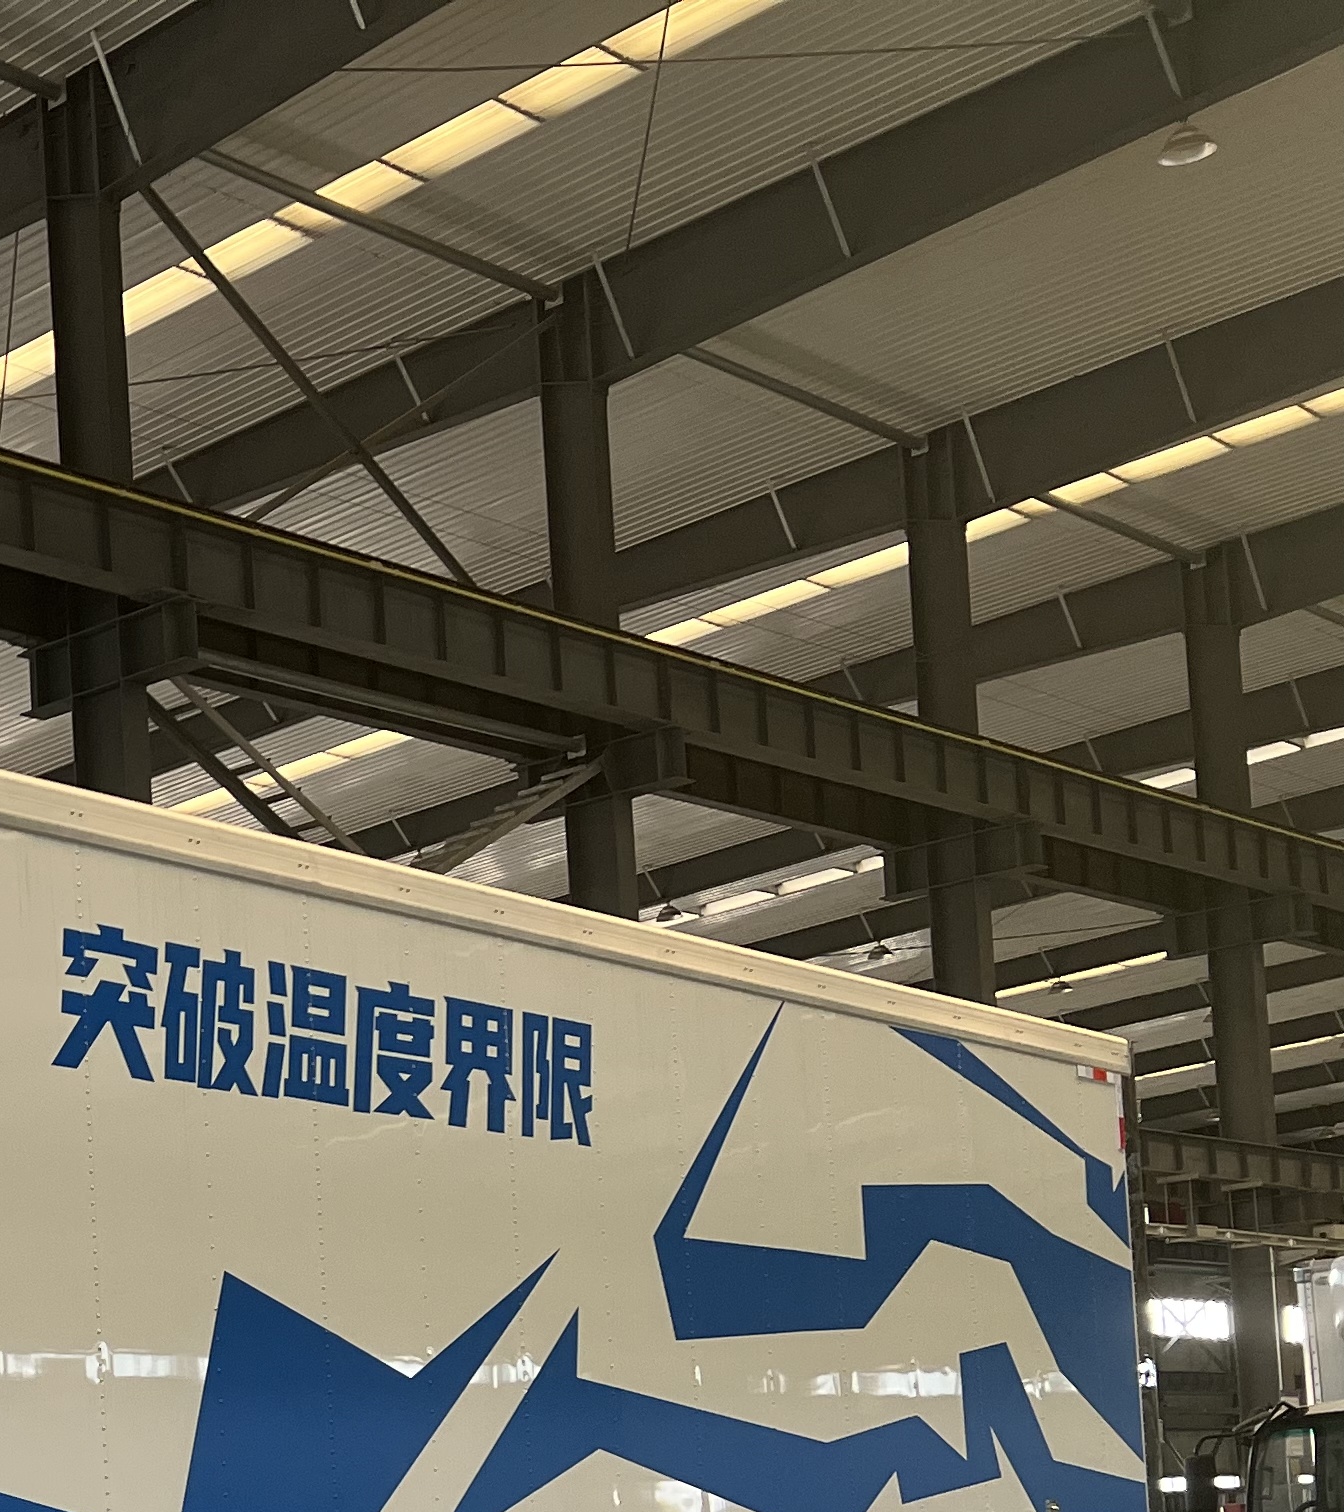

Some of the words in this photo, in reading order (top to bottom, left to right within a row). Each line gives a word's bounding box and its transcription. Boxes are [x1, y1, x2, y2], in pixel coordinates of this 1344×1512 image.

[51, 923, 594, 1147] 突破温度界限
